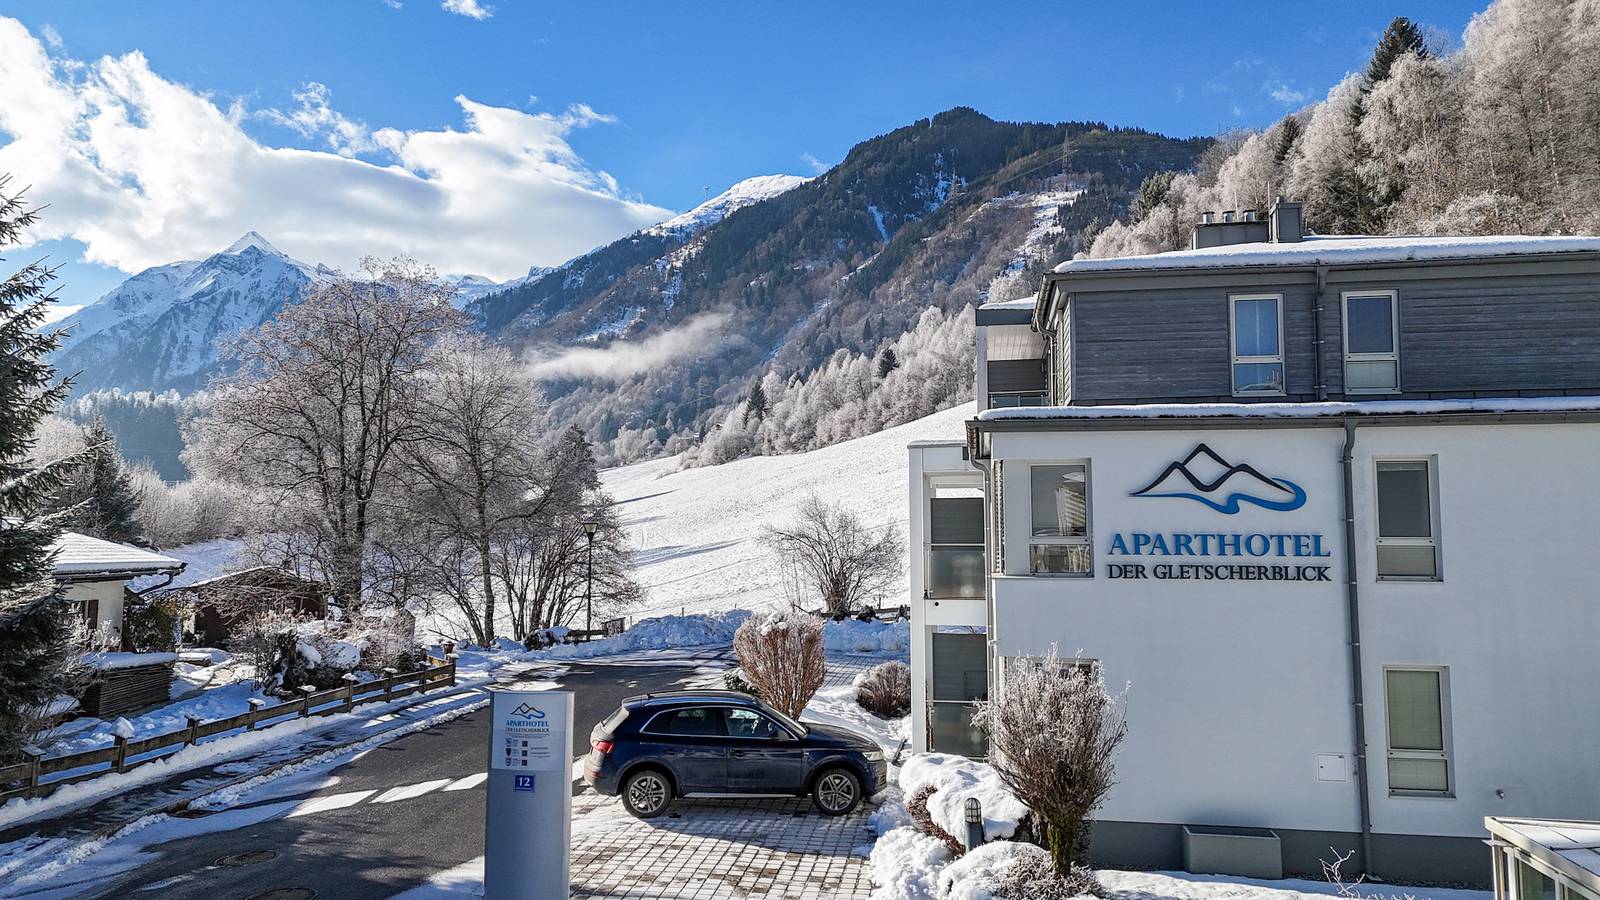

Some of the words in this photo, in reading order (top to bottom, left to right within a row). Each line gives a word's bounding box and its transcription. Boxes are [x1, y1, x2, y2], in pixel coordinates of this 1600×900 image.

[1107, 533, 1331, 557] APARTHOTEL
[1108, 564, 1148, 579] DER
[1153, 565, 1332, 581] GLETSCHERBLICK
[519, 777, 530, 787] 12
